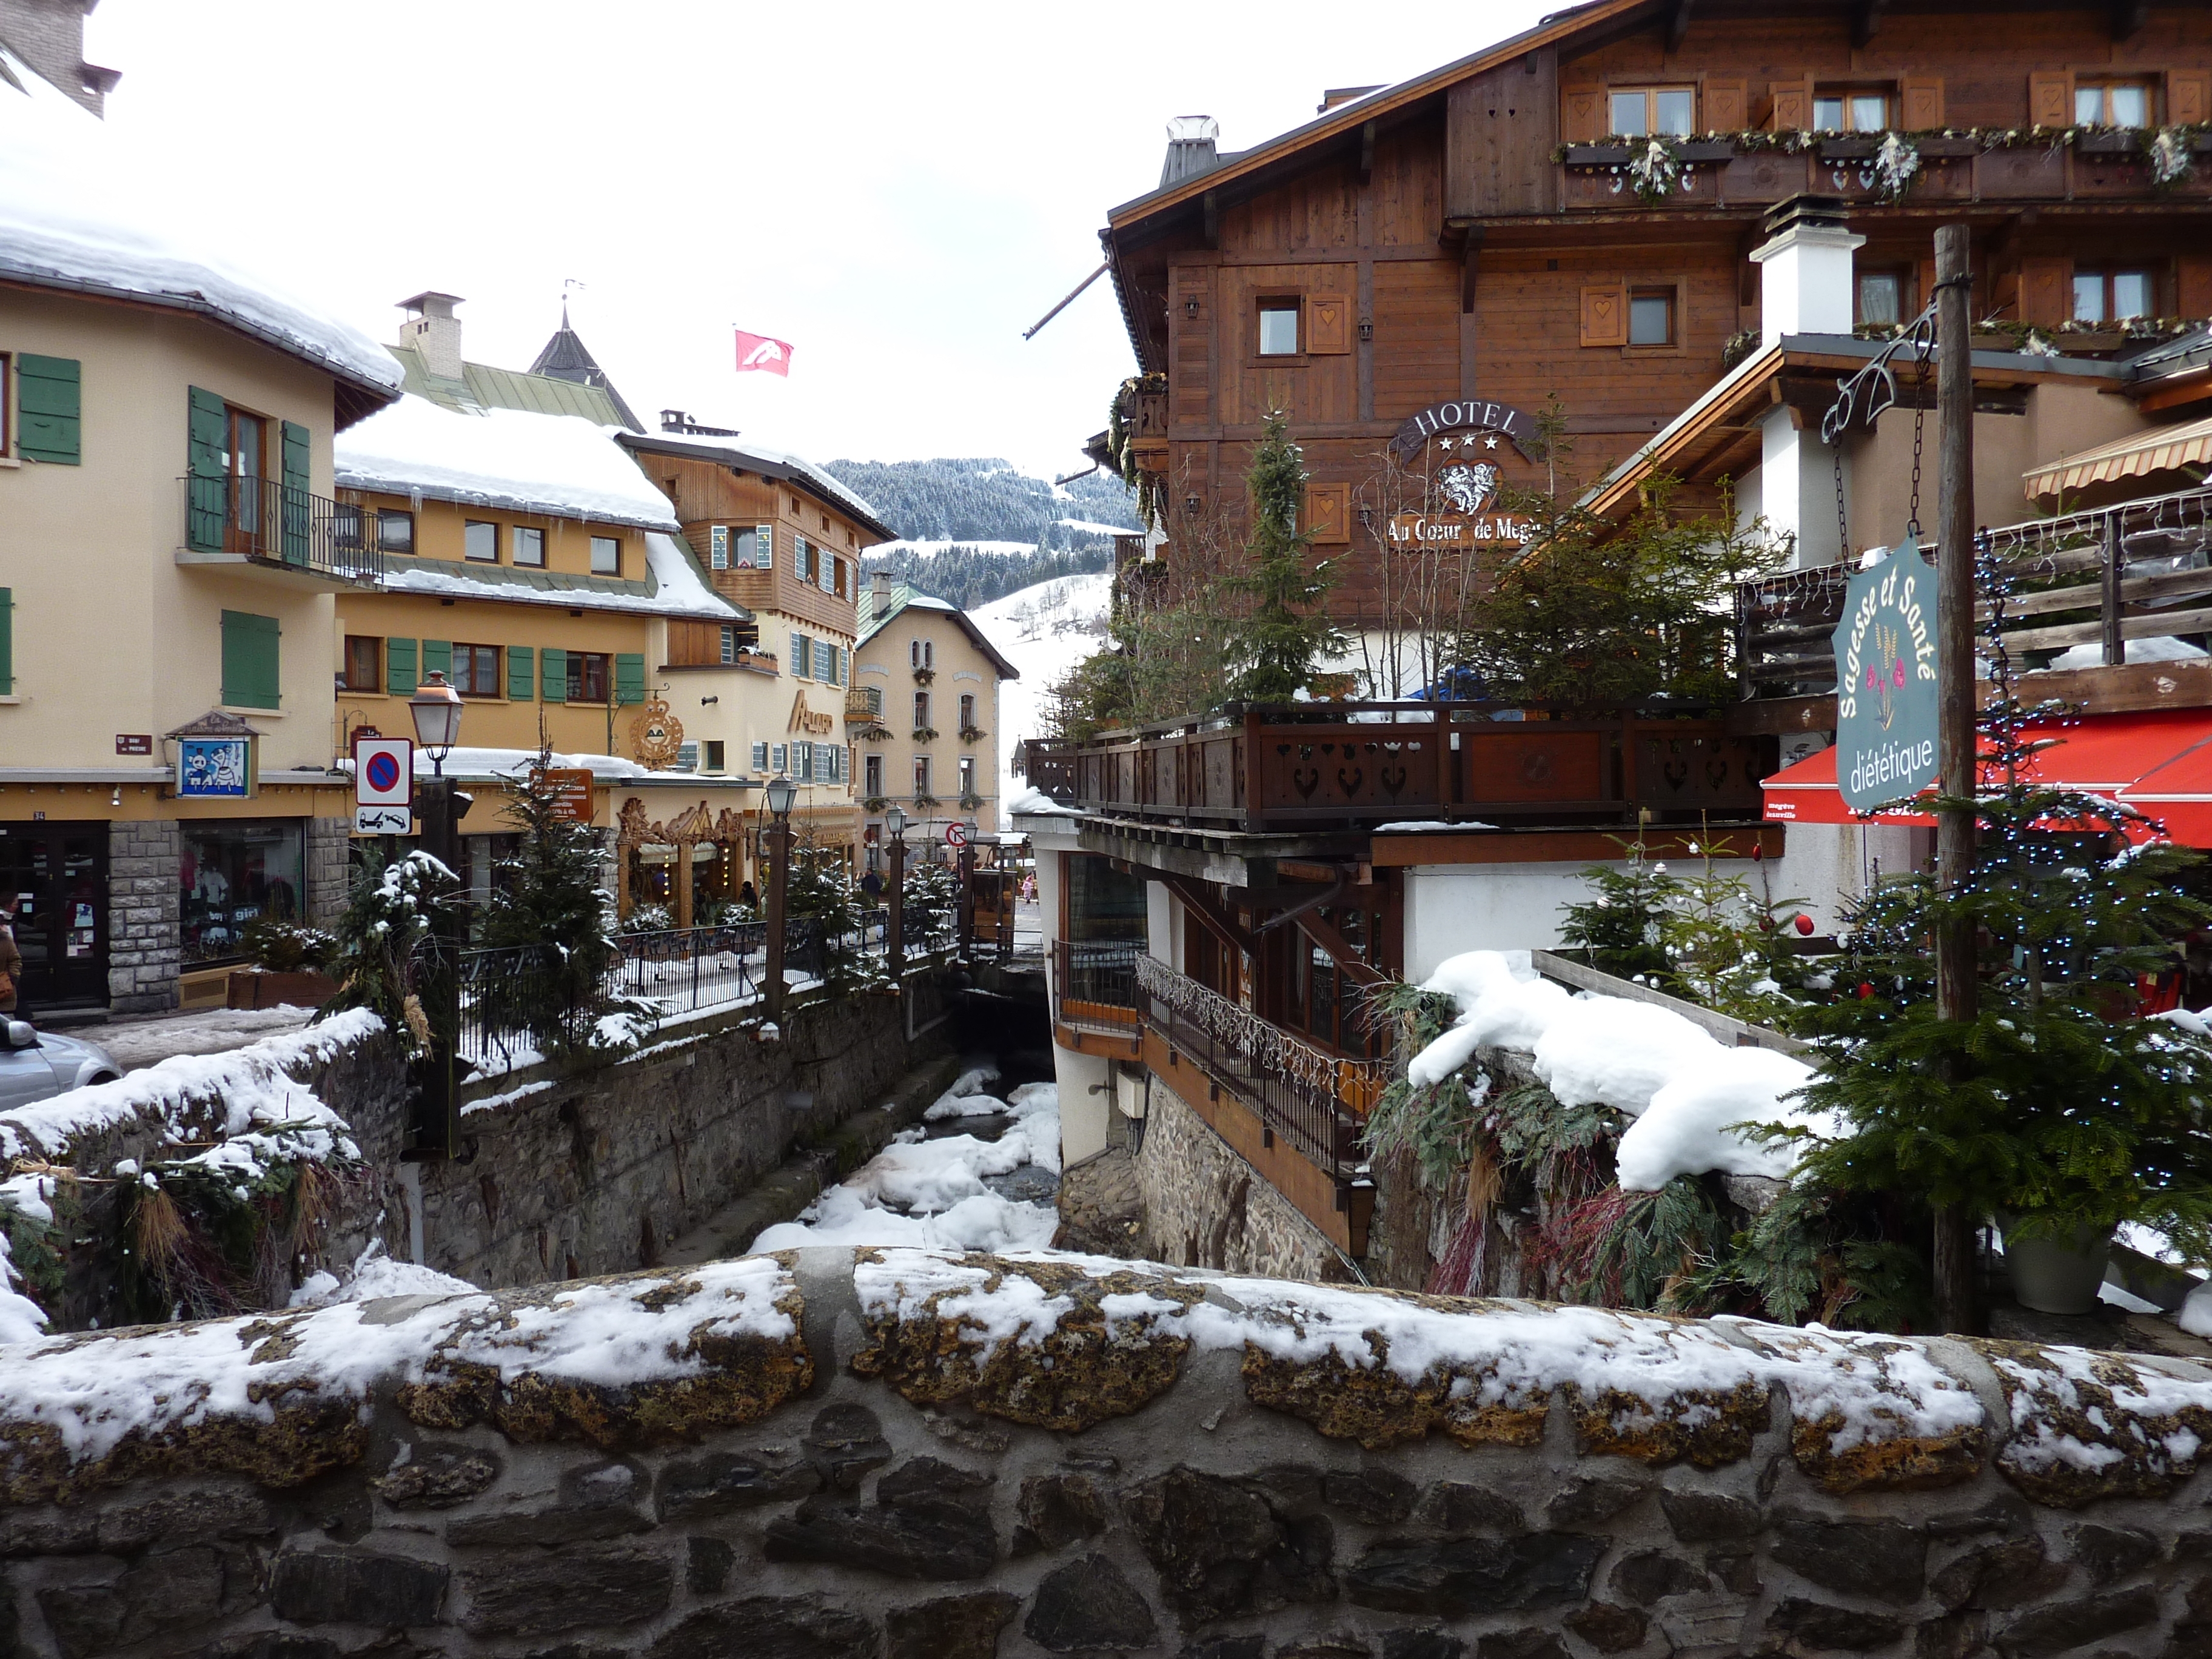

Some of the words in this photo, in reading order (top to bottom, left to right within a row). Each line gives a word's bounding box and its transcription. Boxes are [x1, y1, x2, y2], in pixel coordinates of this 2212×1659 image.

[1415, 402, 1517, 436] HOTEL
[1389, 520, 1410, 541] Au
[1475, 518, 1492, 540] de
[1841, 586, 1877, 719] Sagesse
[1881, 565, 1897, 607] et
[1899, 576, 1937, 681] Santé
[1851, 739, 1932, 794] diététique
[235, 908, 258, 920] girl
